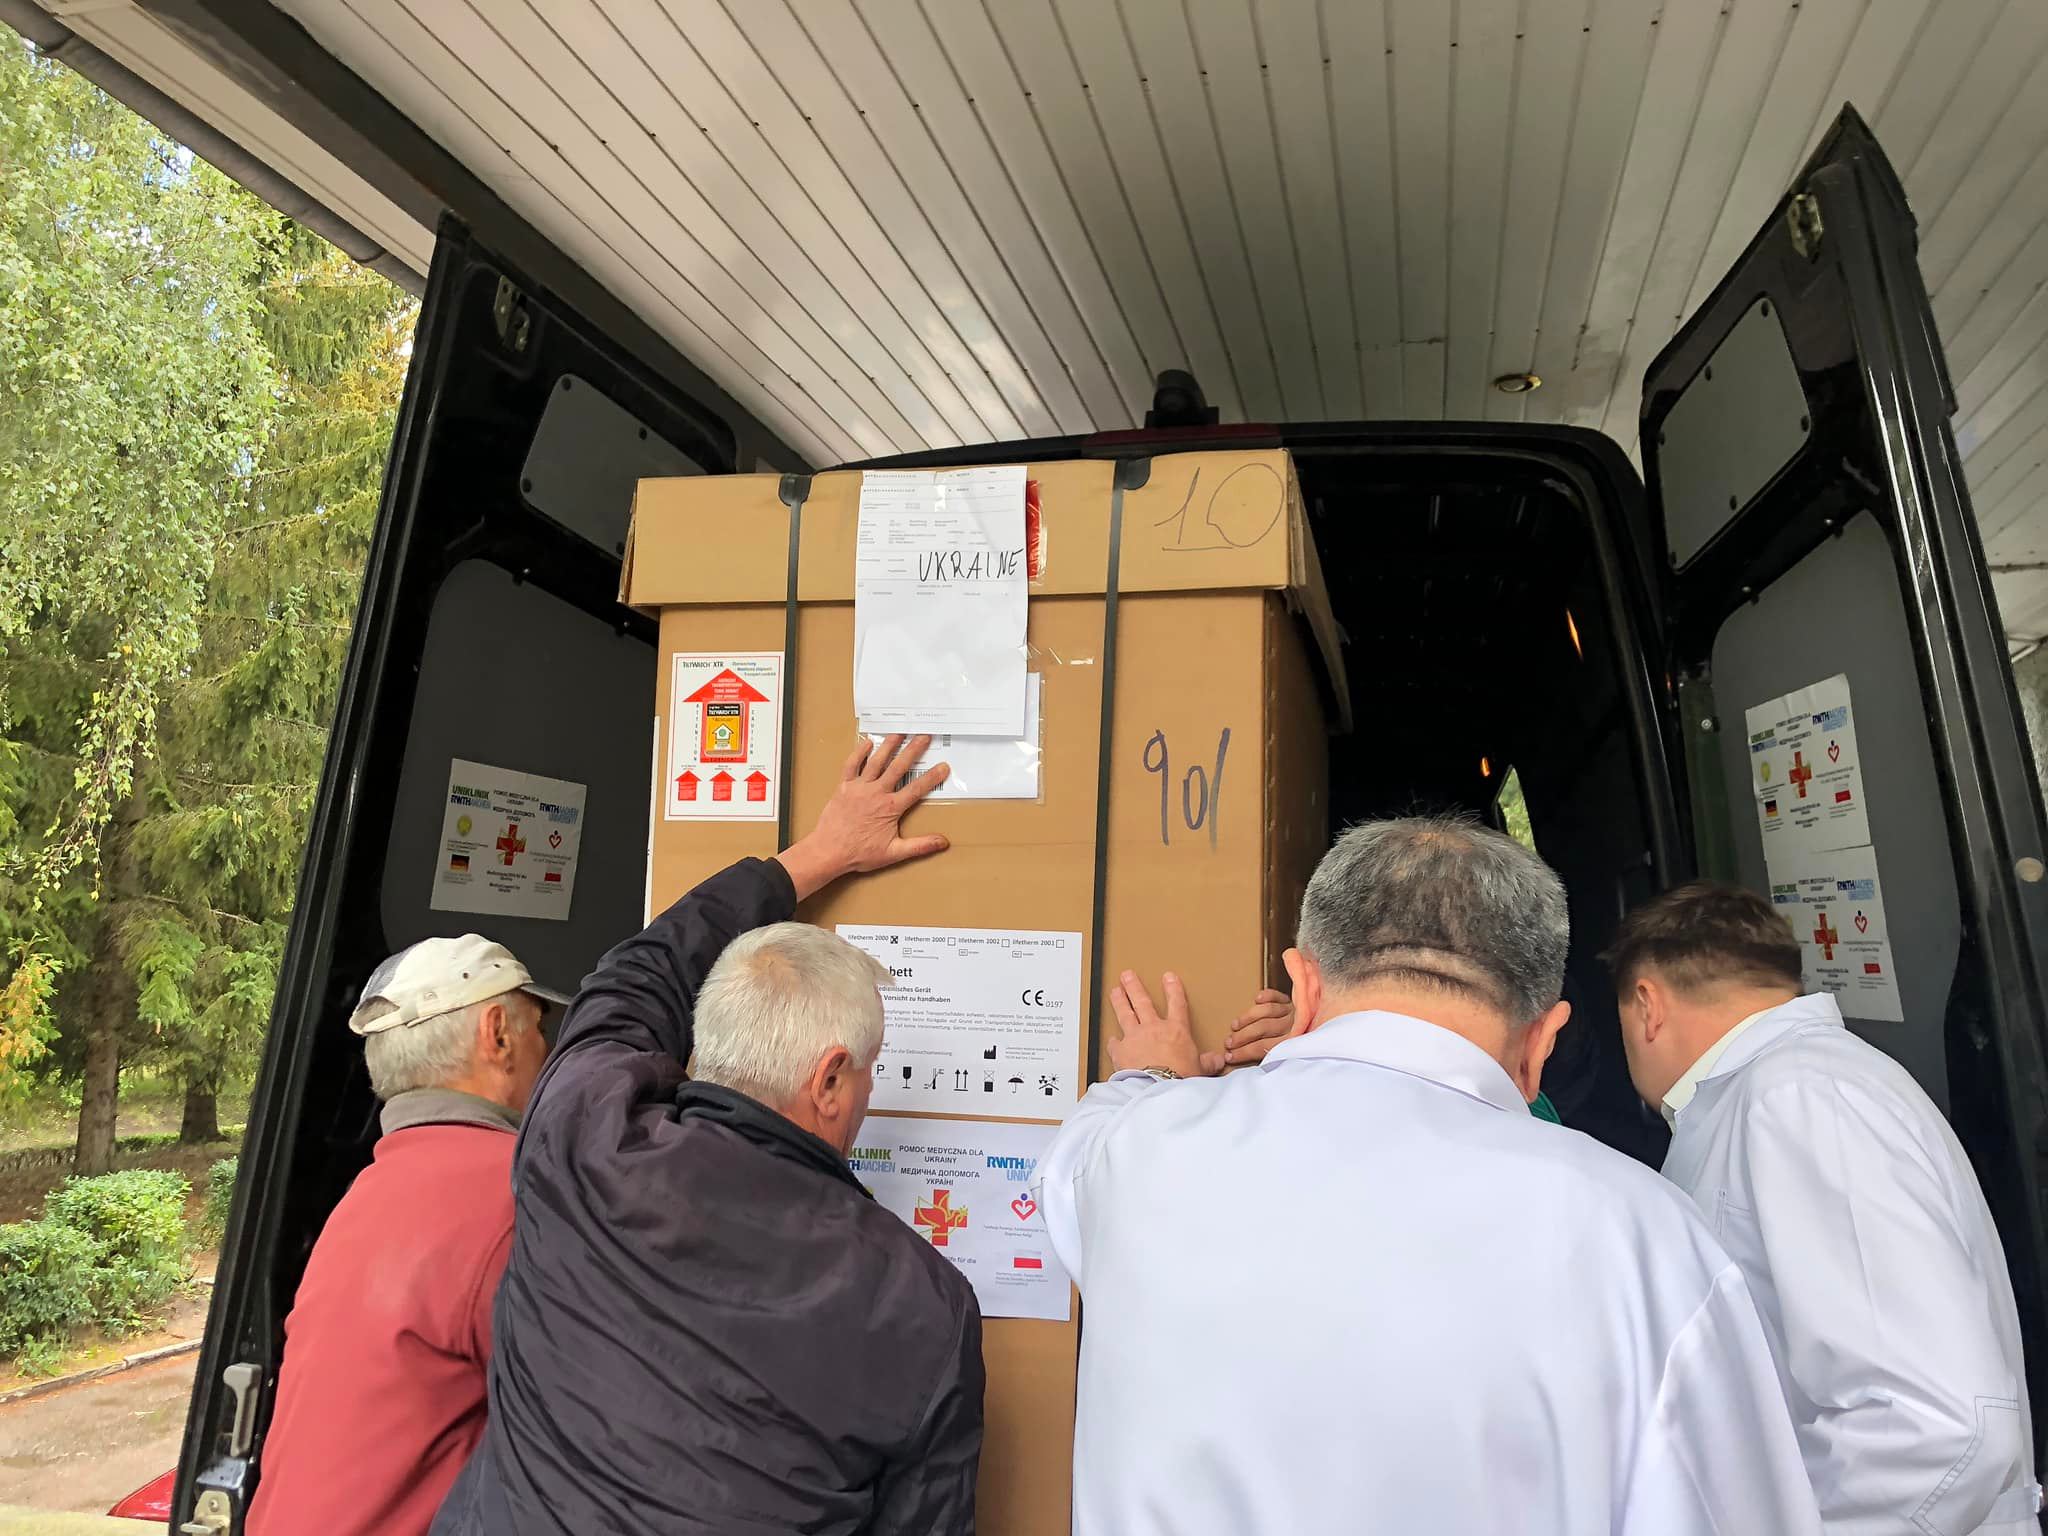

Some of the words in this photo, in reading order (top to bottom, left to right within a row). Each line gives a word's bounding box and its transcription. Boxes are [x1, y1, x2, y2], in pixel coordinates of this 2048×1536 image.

[919, 548, 1024, 582] UKRAINE
[898, 1144, 925, 1154] POMOC
[926, 1146, 966, 1157] MEDYCZNA
[924, 1156, 957, 1165] UKRAINY
[899, 1167, 937, 1177] МЕДИЧНА
[937, 1170, 981, 1179] ДОПОМОГА
[925, 1178, 955, 1186] УКРАЇНІ
